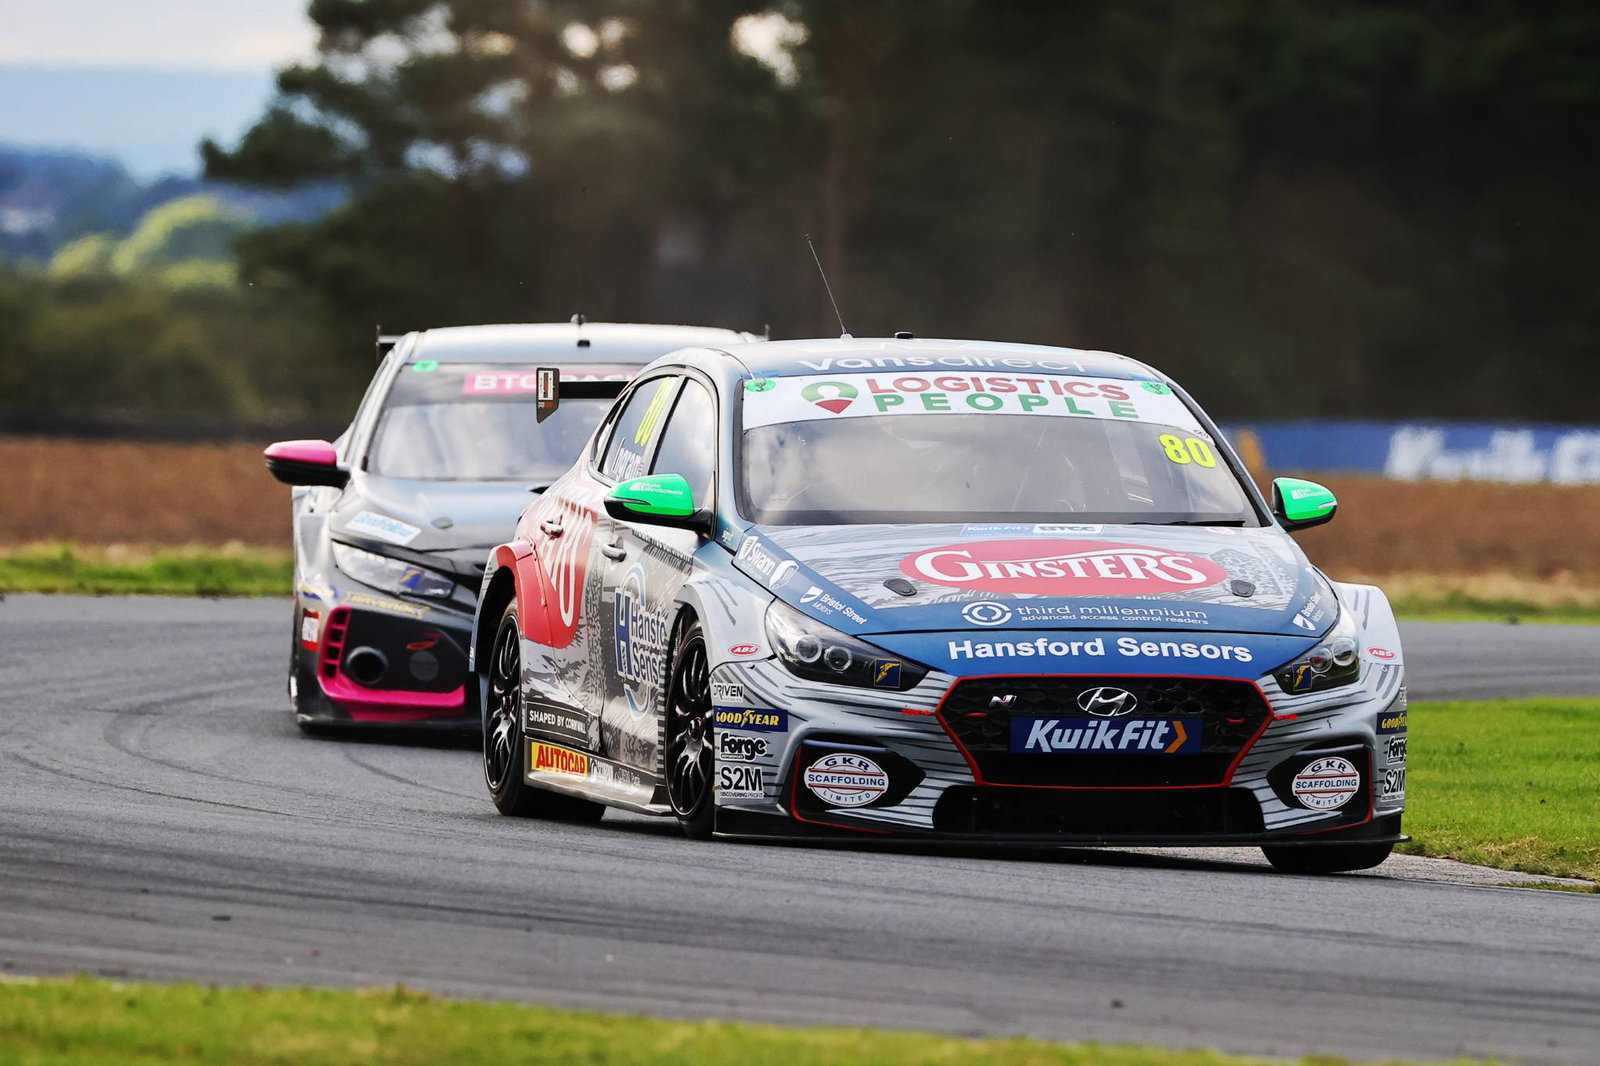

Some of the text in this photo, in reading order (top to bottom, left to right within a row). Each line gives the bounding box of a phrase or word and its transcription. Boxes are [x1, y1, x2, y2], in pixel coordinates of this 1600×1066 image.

[865, 376, 1130, 401] LOGISTICS
[872, 393, 1139, 419] PEOPLE
[1158, 434, 1217, 468] 80
[914, 548, 1207, 584] GINSTERS
[1016, 604, 1207, 619] third millennium
[1165, 617, 1209, 625] readers
[734, 645, 756, 653] ABS
[948, 637, 1253, 662] Hansford Sensors
[529, 710, 555, 725] SHAPED
[557, 715, 564, 727] BY
[715, 710, 780, 727] GOODYEAR
[824, 757, 871, 771] GKR
[1310, 760, 1347, 772] GKR
[720, 766, 763, 791] S2M
[808, 774, 885, 787] SCAFFOLDING
[1295, 778, 1357, 790] SCAFFOLDING
[823, 791, 871, 803] LIMITED
[1305, 794, 1345, 807] LIMITED
